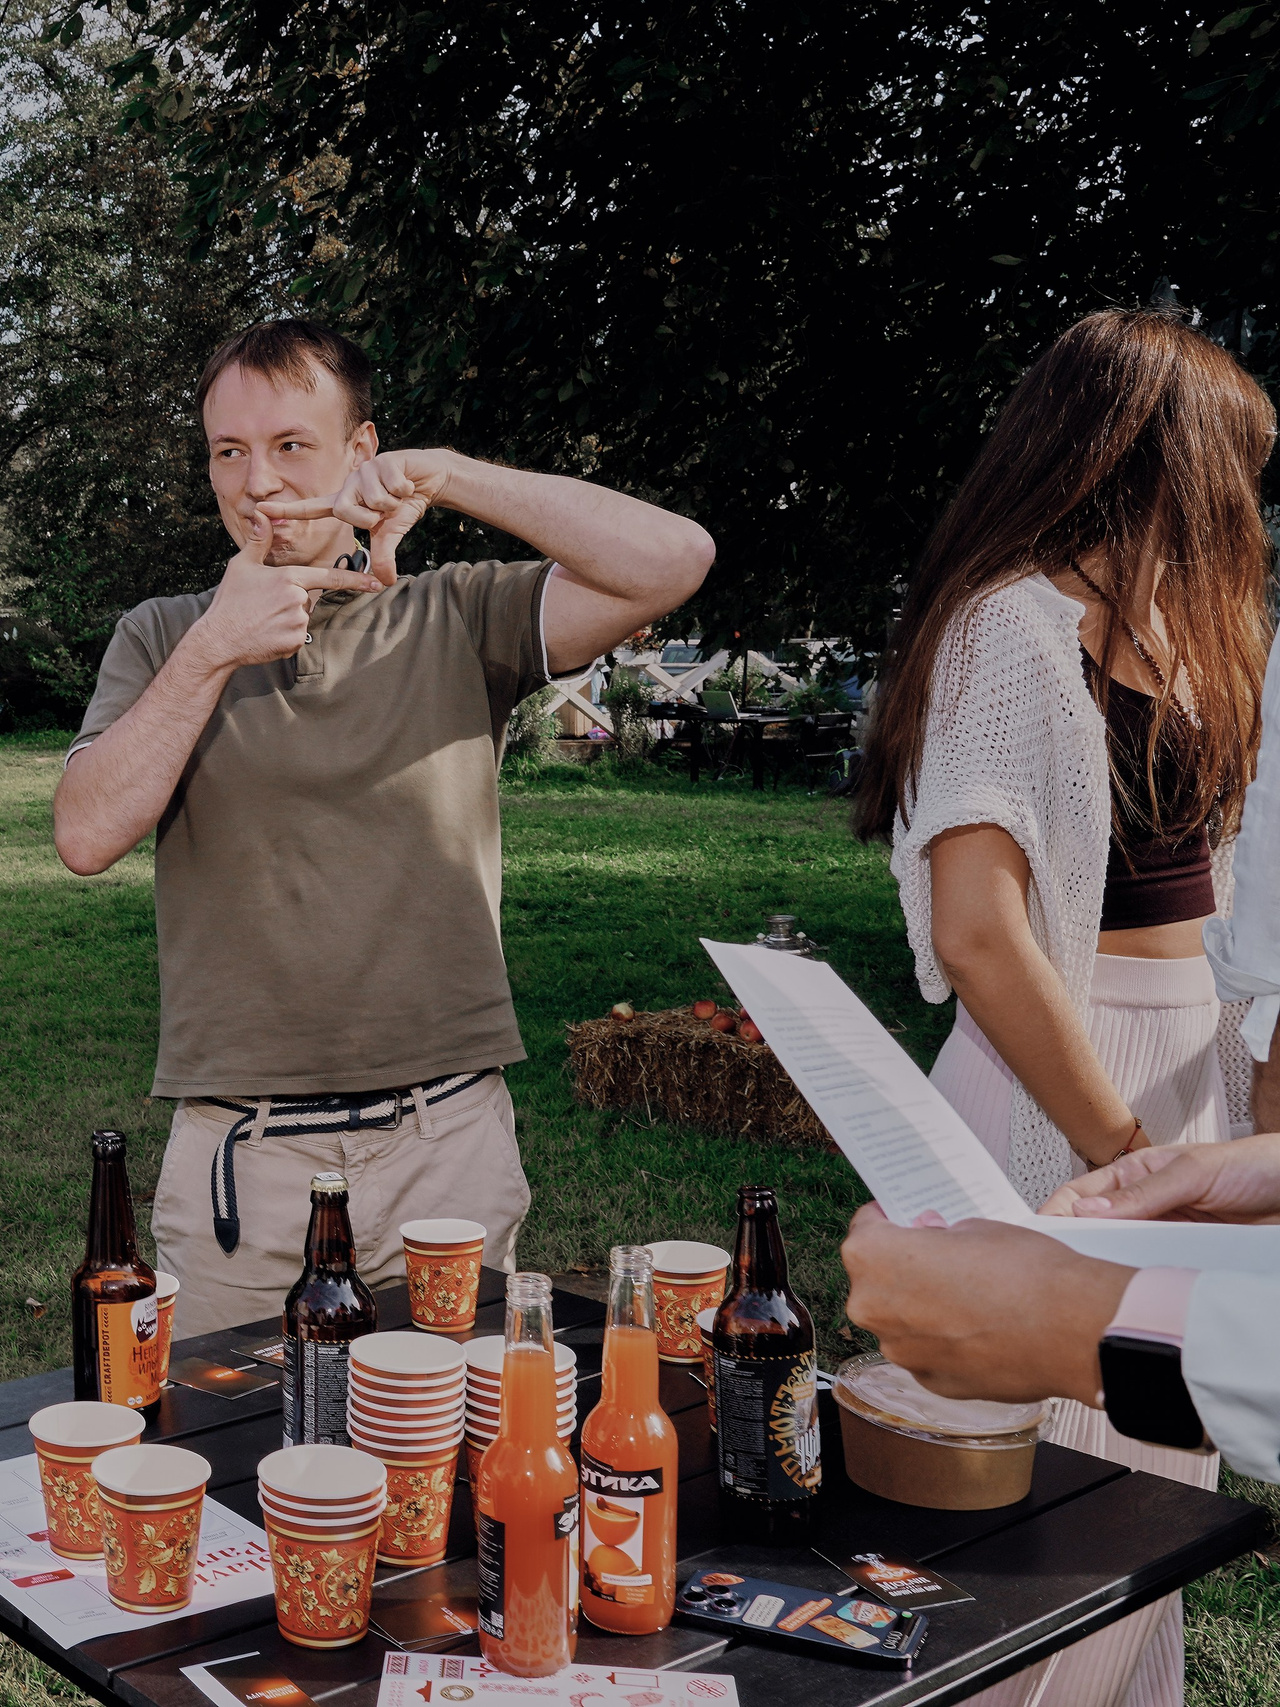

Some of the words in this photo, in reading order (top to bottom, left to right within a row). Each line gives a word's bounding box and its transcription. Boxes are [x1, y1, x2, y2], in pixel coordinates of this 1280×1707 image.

[102, 1330, 111, 1385] CRAFTDEPOT
[581, 1463, 660, 1492] ЭТИКА
[193, 1554, 273, 1588] lavi
